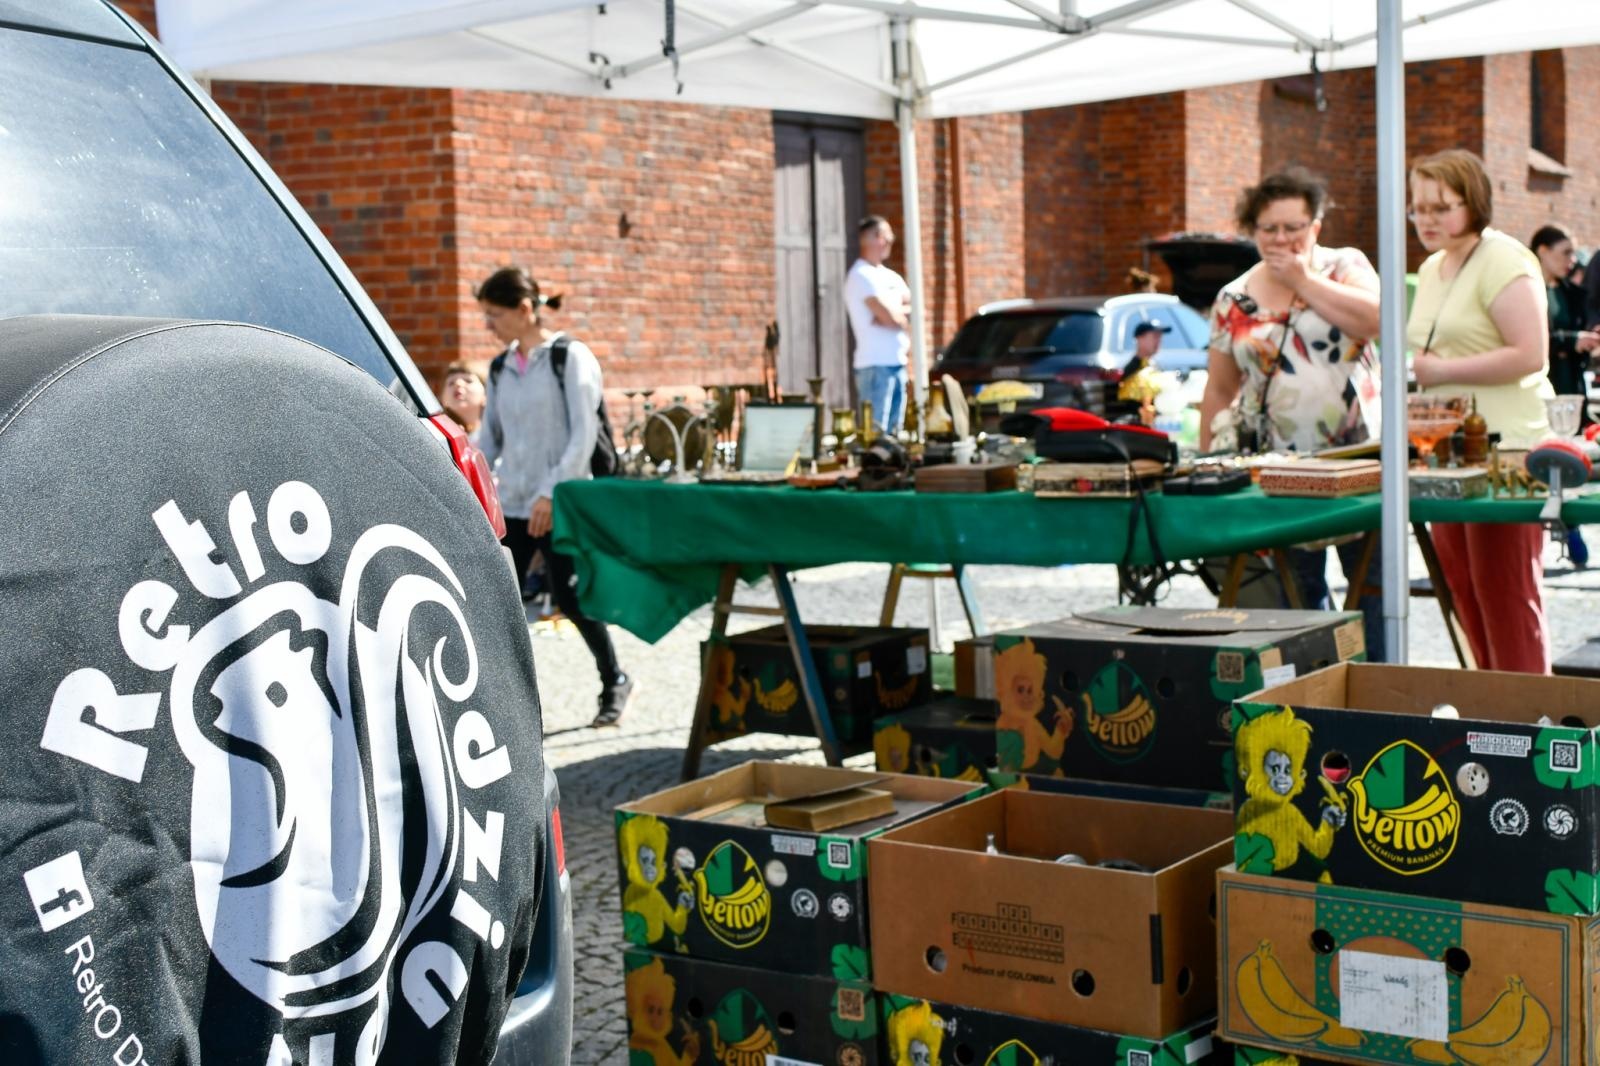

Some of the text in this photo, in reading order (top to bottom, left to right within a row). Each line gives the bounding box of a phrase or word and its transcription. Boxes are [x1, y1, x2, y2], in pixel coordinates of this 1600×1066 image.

[40, 480, 332, 784] Retro
[1083, 694, 1155, 746] yellow
[1349, 781, 1457, 851] yellow
[1367, 838, 1445, 865] PREMIUM BANANAS
[695, 870, 769, 930] yellow
[65, 935, 150, 1066] RetrO D
